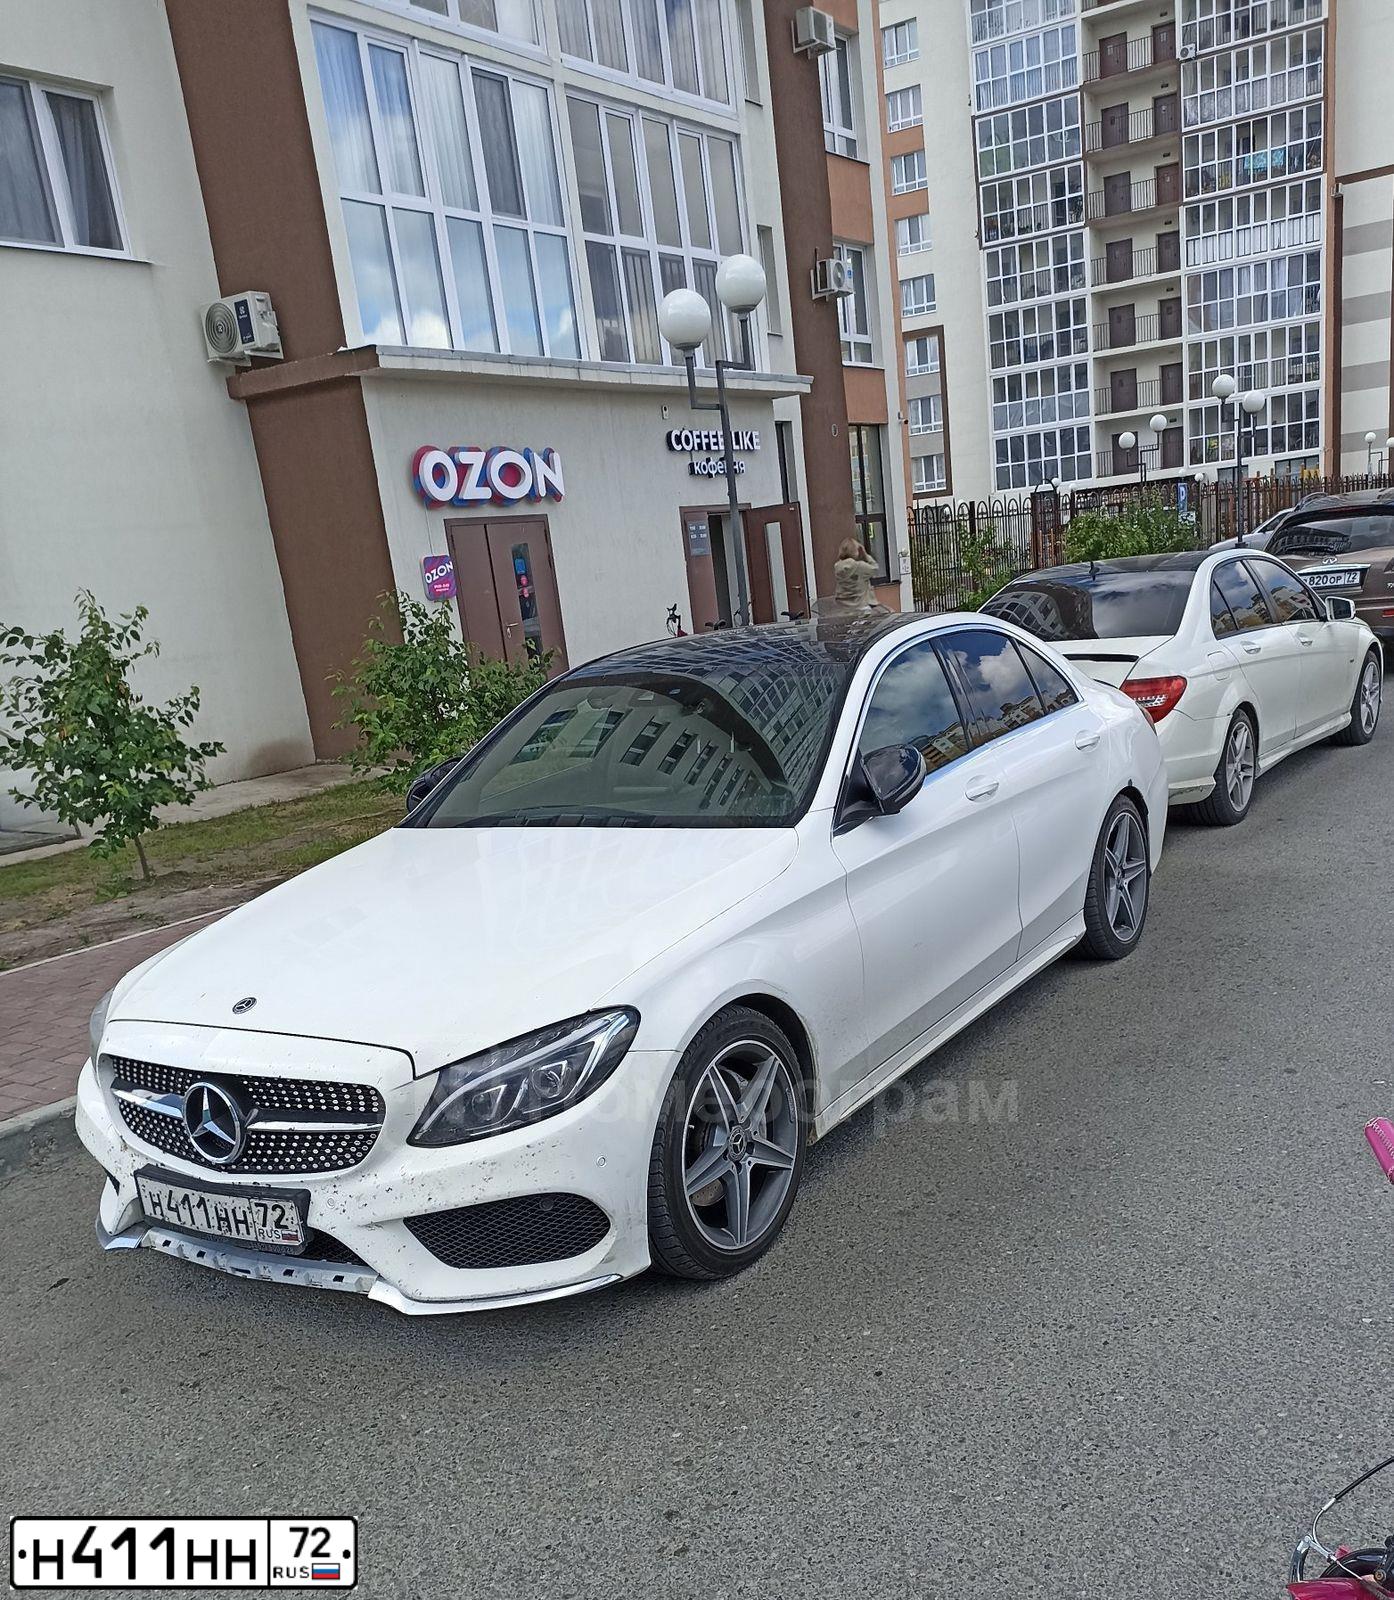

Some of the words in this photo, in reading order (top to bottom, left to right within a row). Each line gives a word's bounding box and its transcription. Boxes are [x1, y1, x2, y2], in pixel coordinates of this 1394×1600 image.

[671, 429, 725, 450] COFFEE
[731, 431, 760, 450] LIKE
[418, 449, 565, 502] OZON
[425, 561, 453, 583] OZON
[255, 1202, 288, 1229] 72
[258, 1228, 281, 1239] RUS
